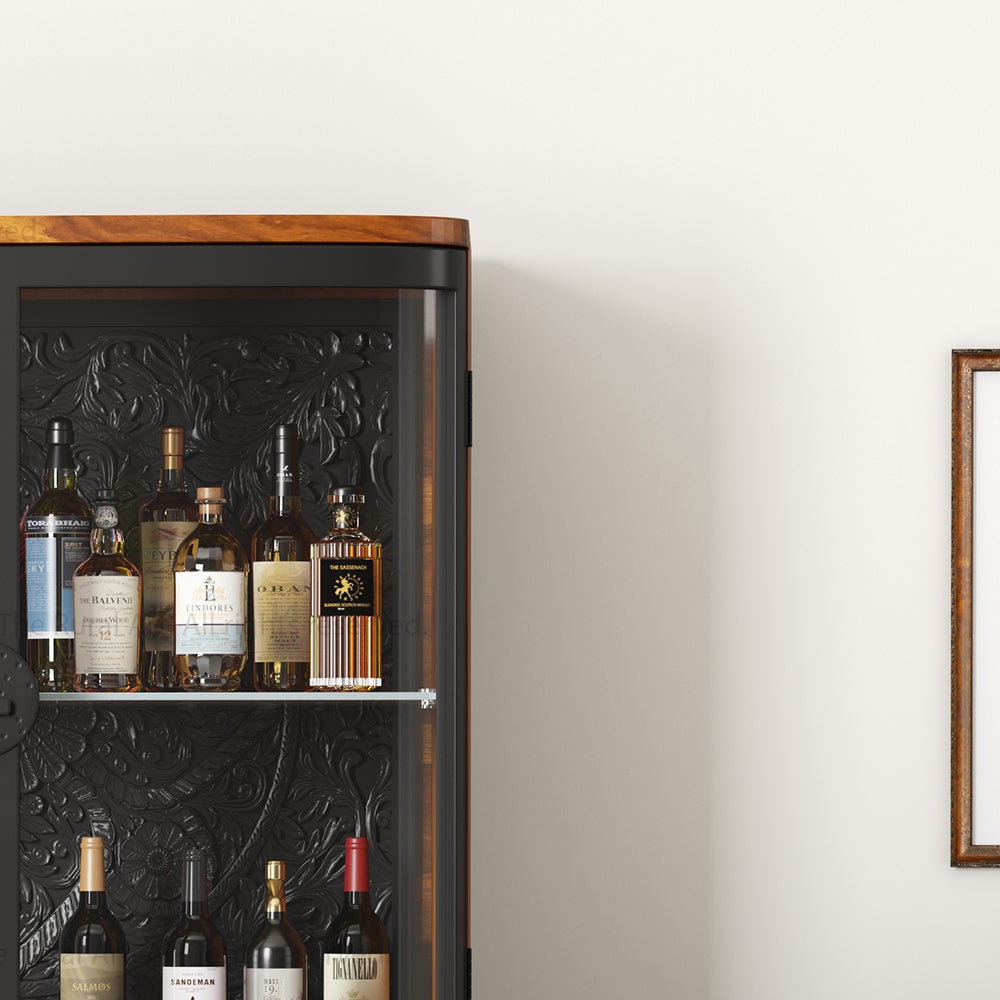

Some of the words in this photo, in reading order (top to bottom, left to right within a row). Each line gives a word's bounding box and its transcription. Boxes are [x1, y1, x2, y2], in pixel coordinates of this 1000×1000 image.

[187, 604, 234, 612] LINDORES
[100, 630, 112, 641] 12
[71, 982, 112, 992] SALMOS
